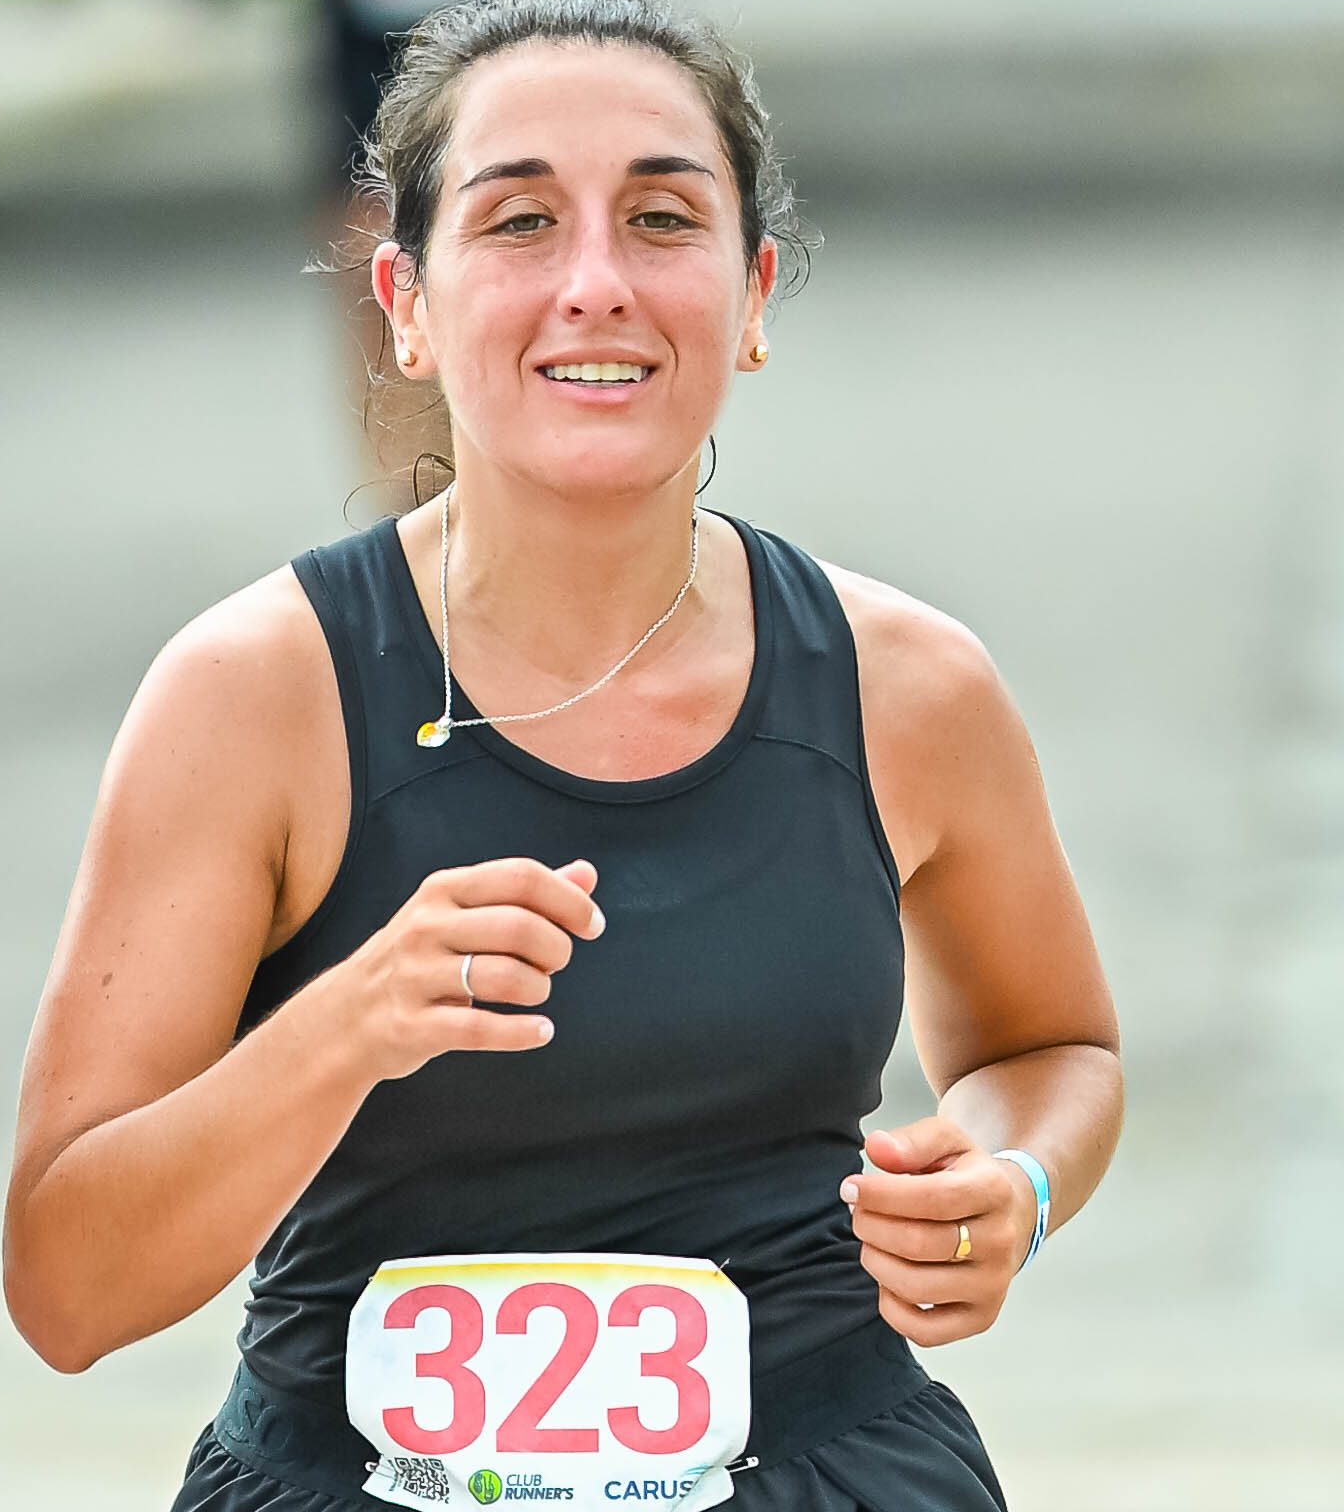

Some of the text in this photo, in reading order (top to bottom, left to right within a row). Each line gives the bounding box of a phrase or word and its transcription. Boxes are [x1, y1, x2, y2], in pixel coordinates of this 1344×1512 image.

[381, 1282, 711, 1456] 323
[506, 1474, 542, 1486] CLUB
[504, 1487, 574, 1501] RUNNER'S
[604, 1480, 695, 1500] CARUS
